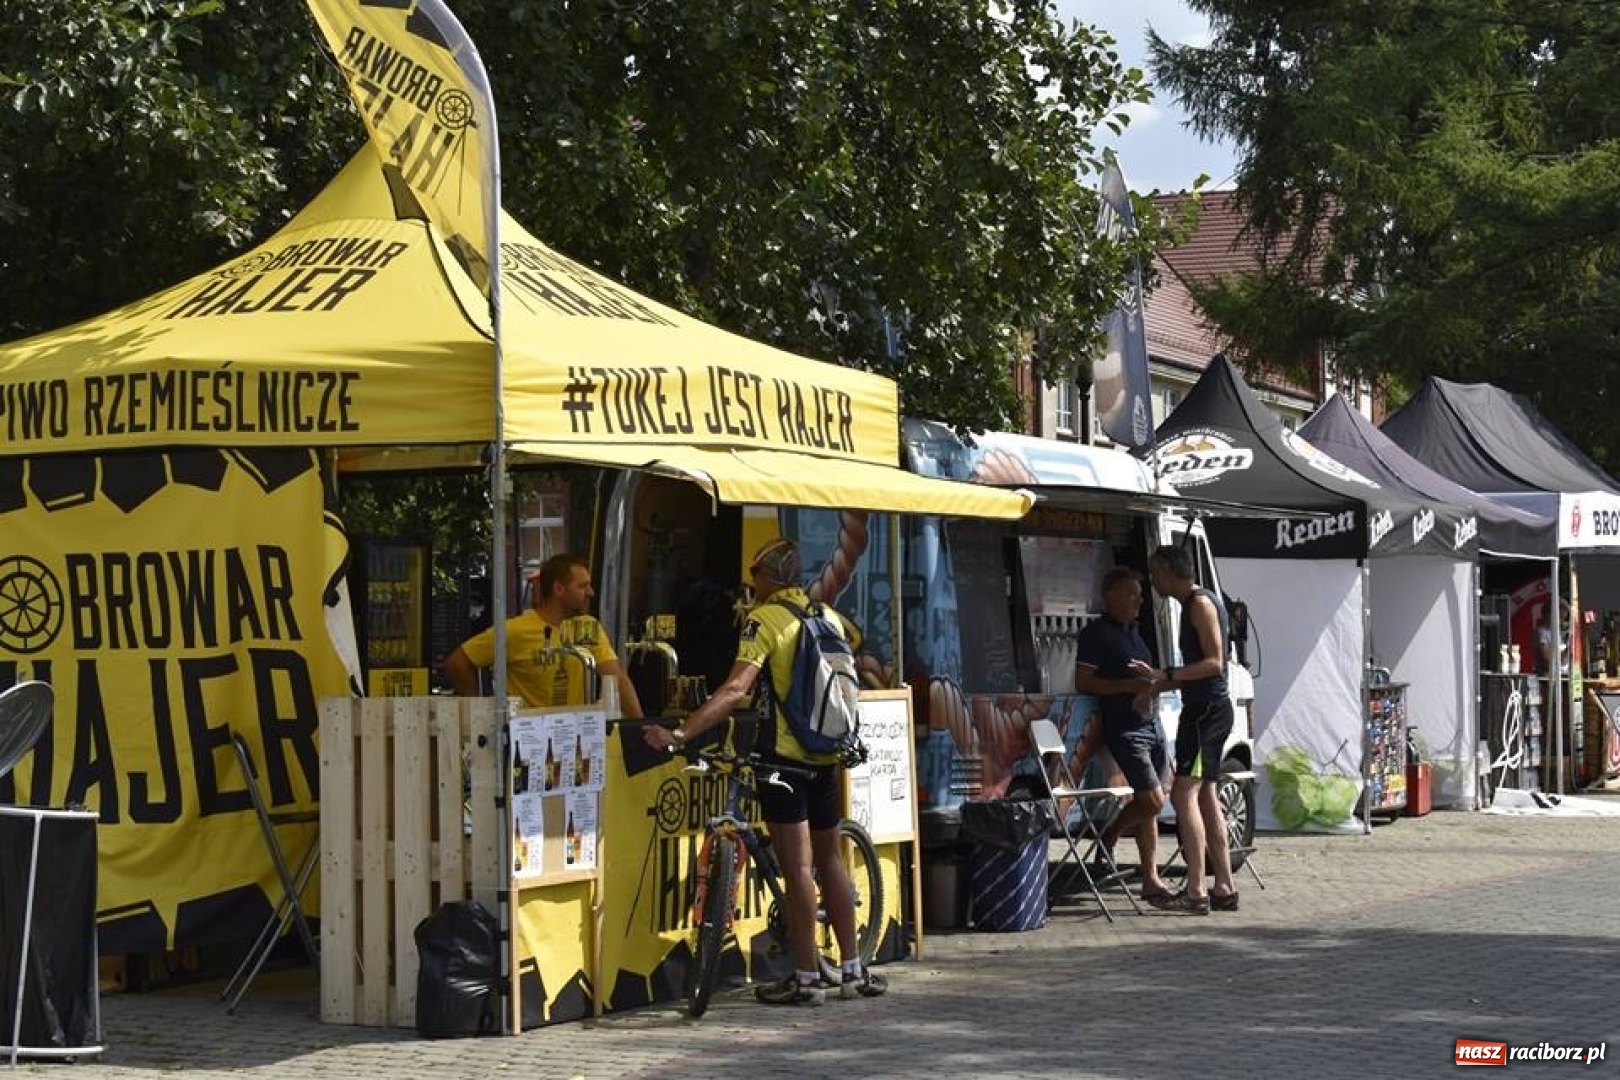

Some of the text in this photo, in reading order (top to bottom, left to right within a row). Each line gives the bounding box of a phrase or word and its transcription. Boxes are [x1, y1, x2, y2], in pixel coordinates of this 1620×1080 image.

[261, 238, 408, 271] BROWAR
[164, 268, 377, 319] HAJER
[84, 361, 361, 436] RZEMIEŚLNICZE
[562, 366, 855, 453] #TUKEJ JEST HAJER
[66, 544, 303, 651] BROWAR
